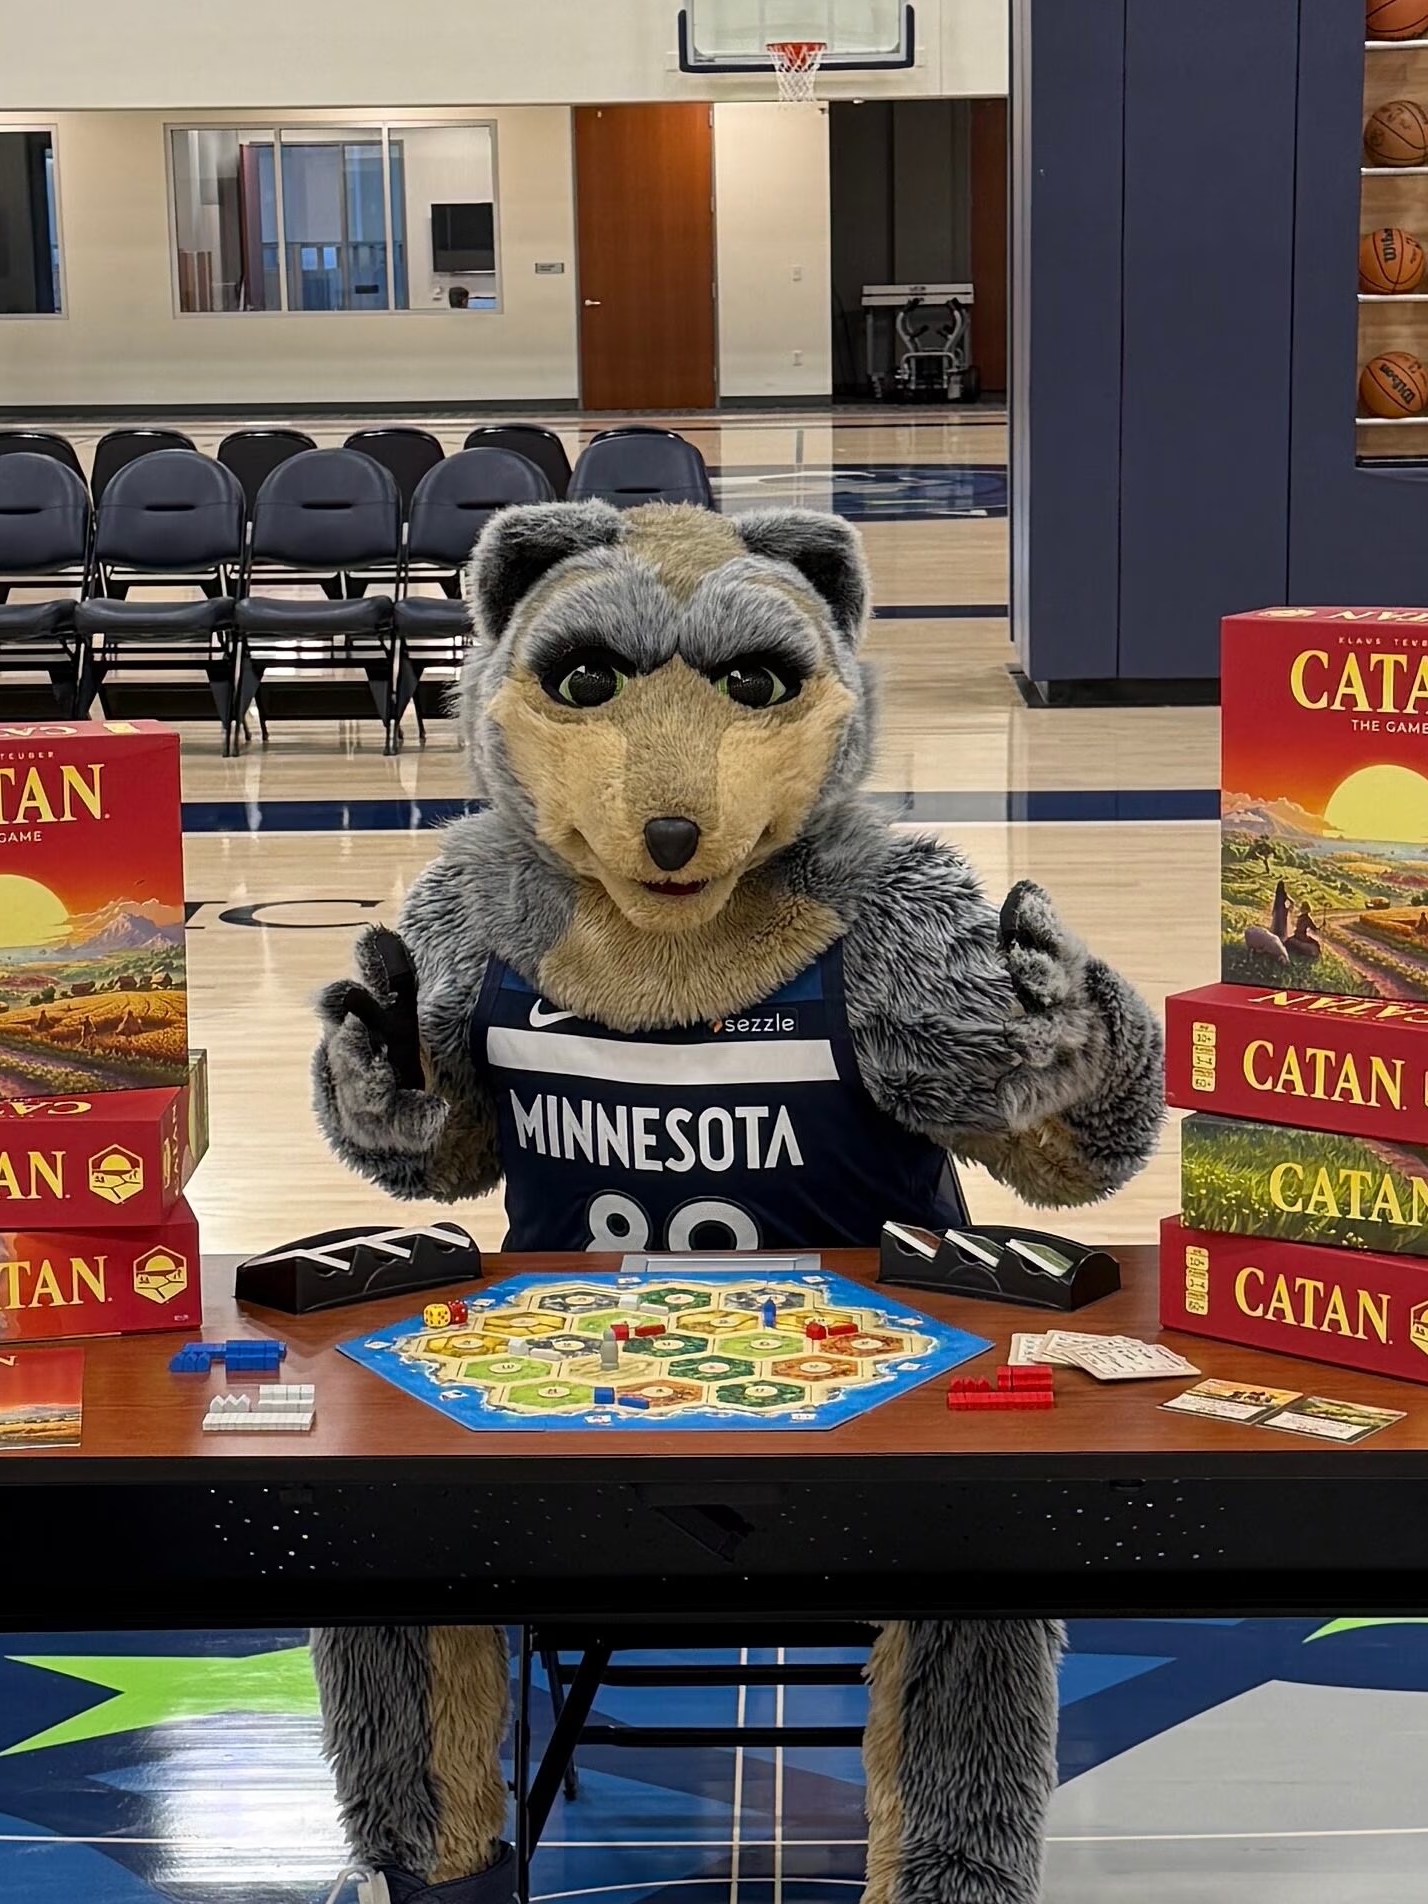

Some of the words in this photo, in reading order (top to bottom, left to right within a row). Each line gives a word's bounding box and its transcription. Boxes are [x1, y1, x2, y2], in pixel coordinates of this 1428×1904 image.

[1378, 364, 1416, 405] Wilson
[1351, 719, 1380, 732] THE
[724, 1012, 796, 1033] sezzle
[1243, 1040, 1406, 1111] CATAN
[509, 1088, 804, 1173] MINNESOTA
[1234, 1266, 1392, 1346] CATAN
